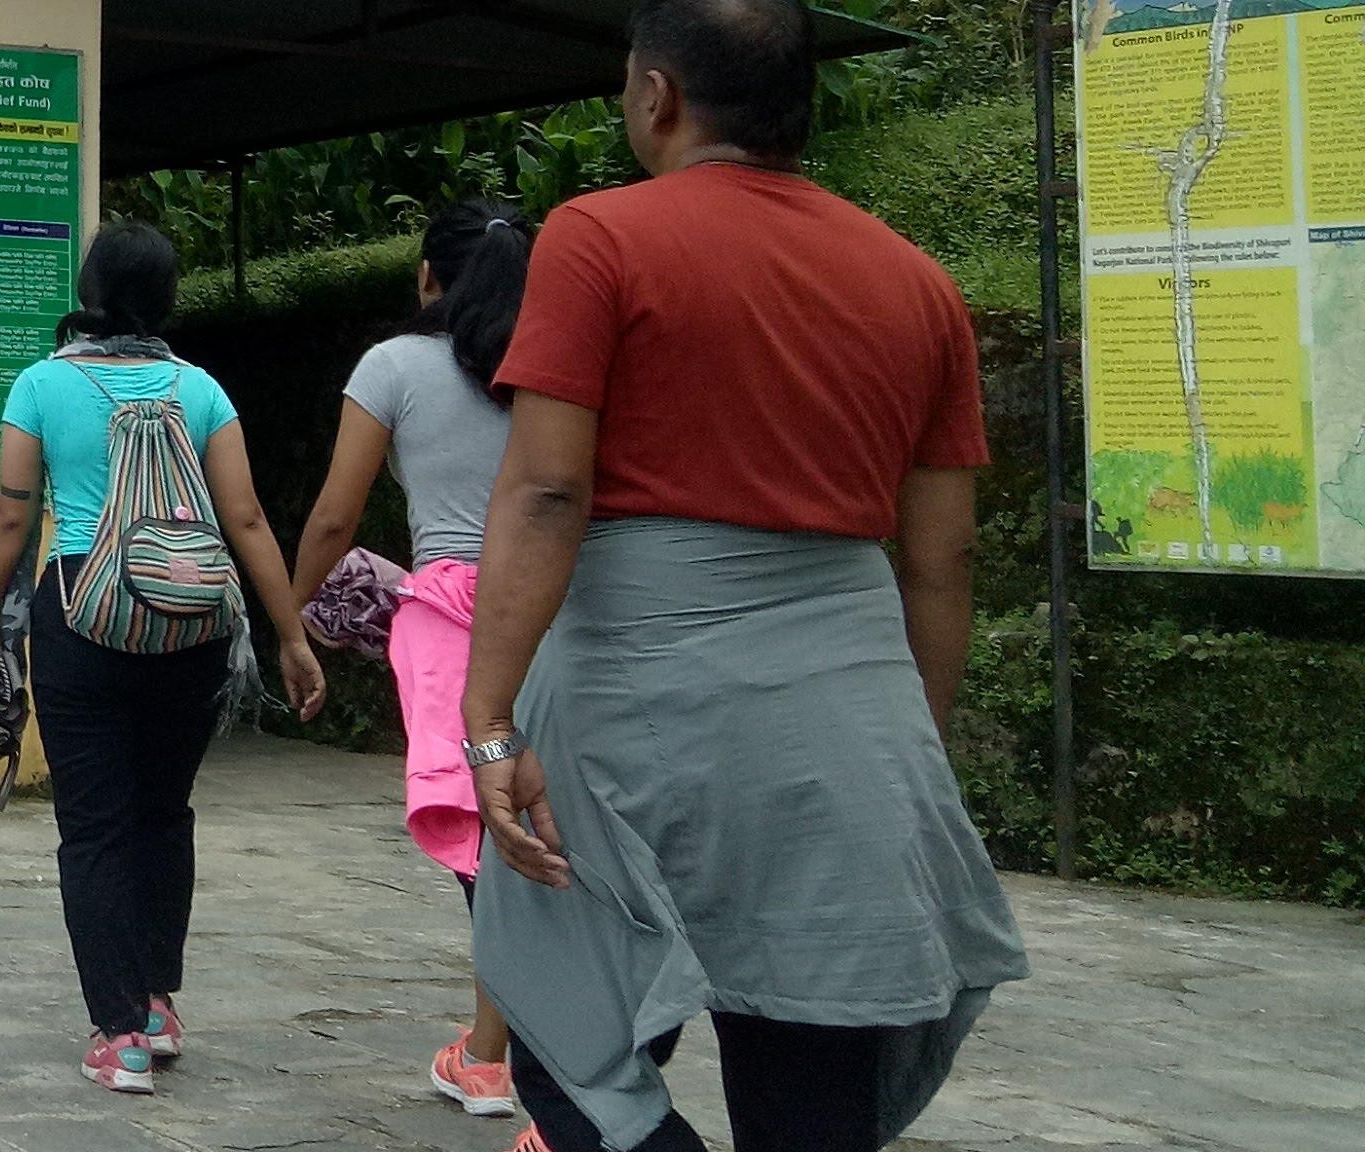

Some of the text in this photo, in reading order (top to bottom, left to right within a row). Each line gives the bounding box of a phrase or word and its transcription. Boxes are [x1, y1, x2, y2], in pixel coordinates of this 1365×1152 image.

[1112, 34, 1162, 48] Common
[1165, 28, 1195, 42] Birds
[1196, 27, 1208, 39] in
[20, 74, 51, 90] कोष
[18, 96, 51, 112] Fund)
[1158, 276, 1211, 290] Viors
